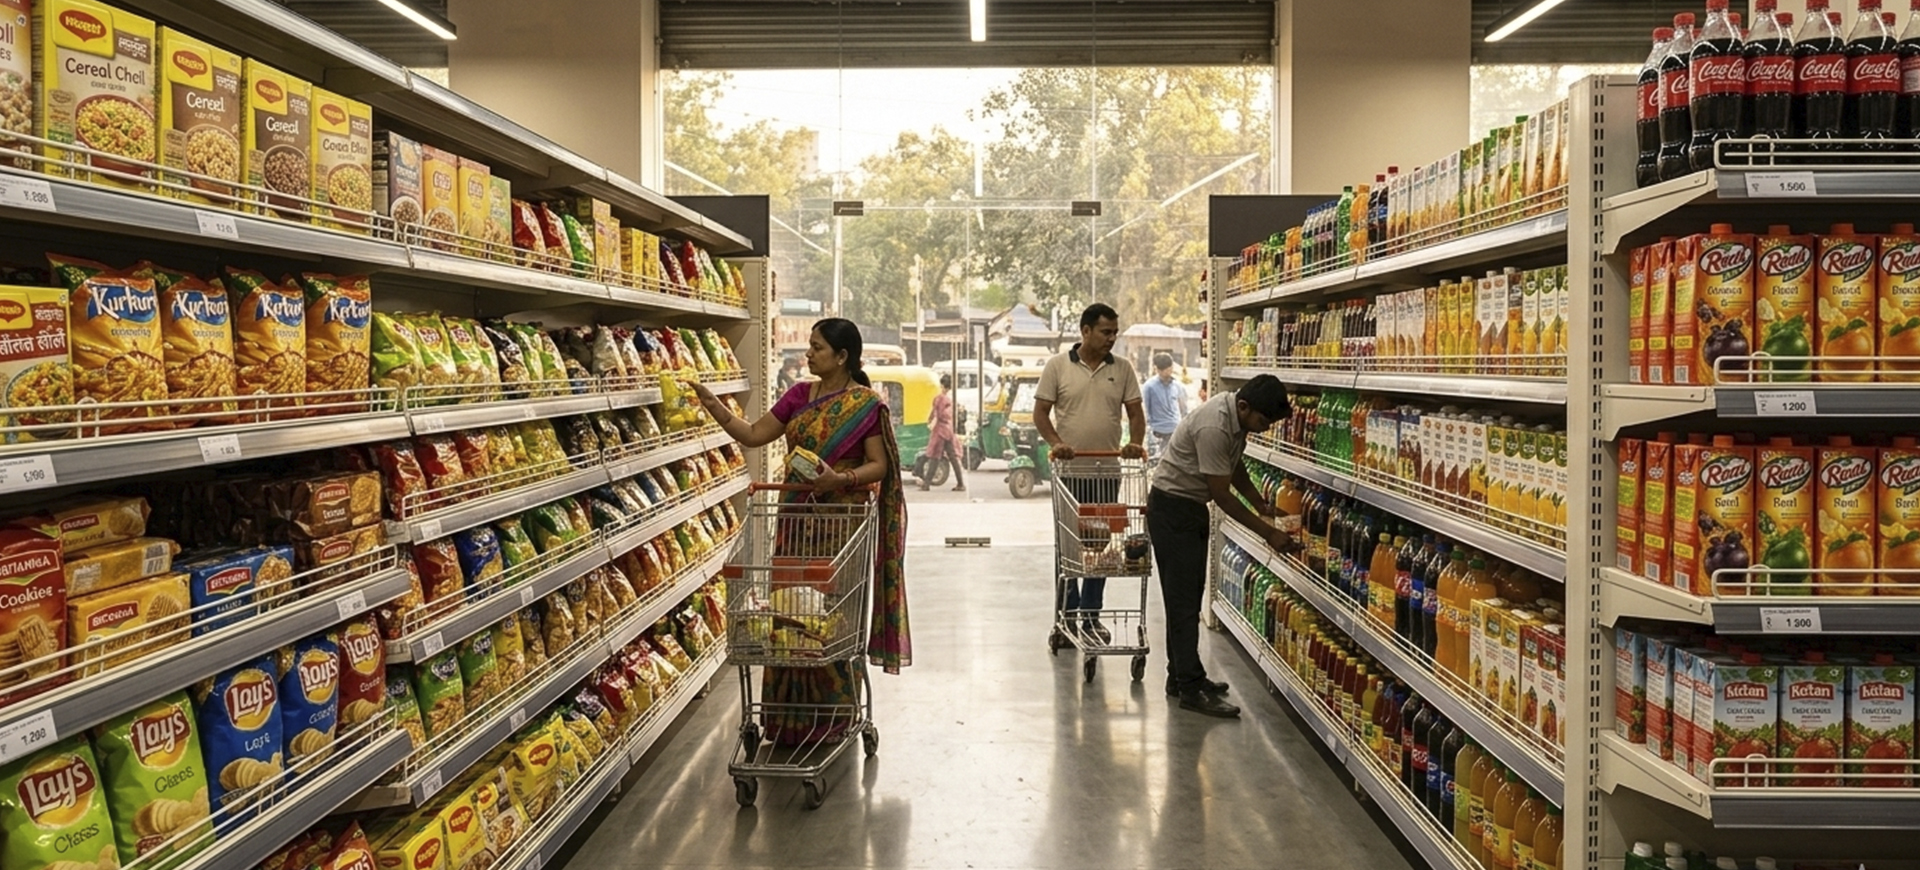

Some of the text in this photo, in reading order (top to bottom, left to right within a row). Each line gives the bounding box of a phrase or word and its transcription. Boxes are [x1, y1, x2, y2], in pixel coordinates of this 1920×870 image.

[65, 57, 112, 79] Cereal
[136, 710, 185, 758] Lays
[24, 762, 88, 816] Lays
